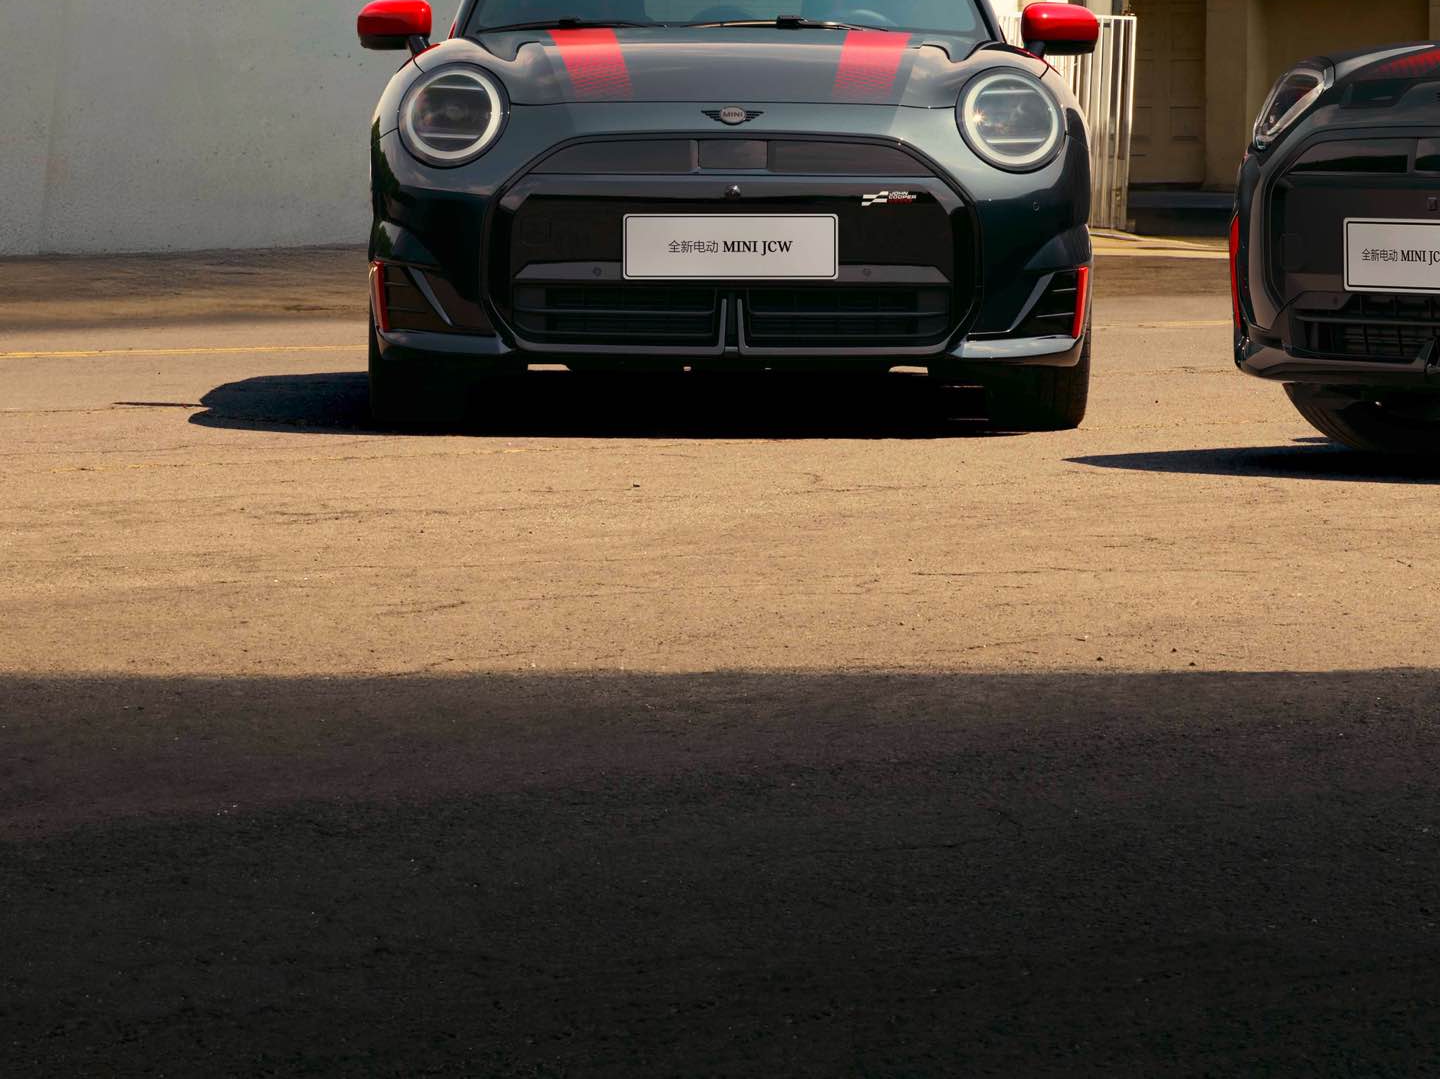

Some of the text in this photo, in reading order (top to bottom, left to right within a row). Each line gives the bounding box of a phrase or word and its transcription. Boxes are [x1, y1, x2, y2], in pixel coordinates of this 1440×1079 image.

[668, 239, 793, 256] 全新电动 MINI JCW
[1361, 249, 1398, 262] 全新电动
[1400, 250, 1426, 263] MINI
